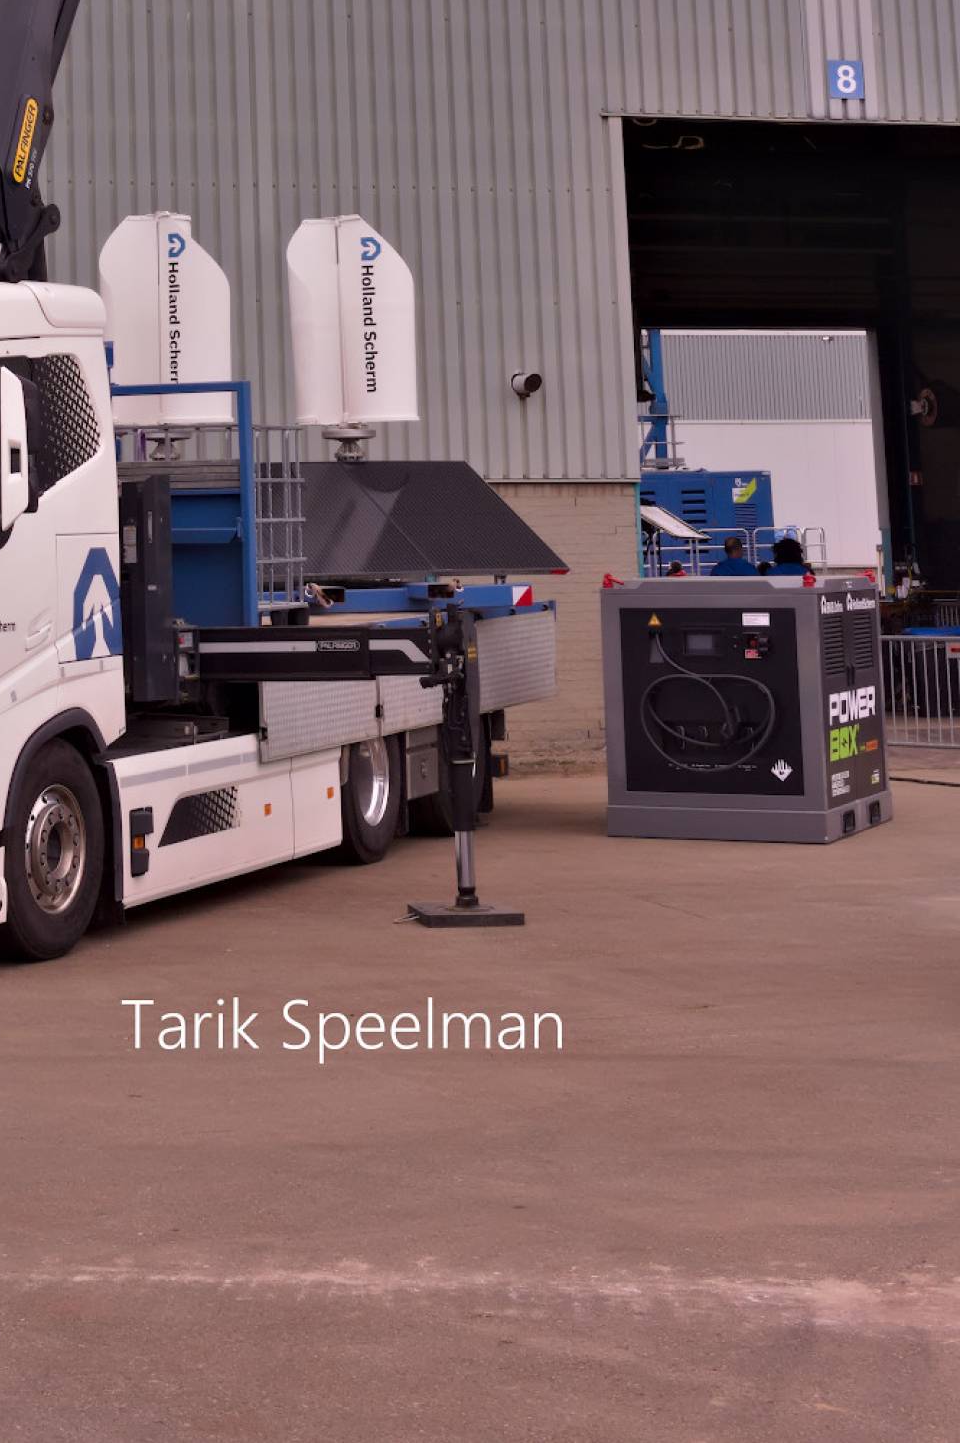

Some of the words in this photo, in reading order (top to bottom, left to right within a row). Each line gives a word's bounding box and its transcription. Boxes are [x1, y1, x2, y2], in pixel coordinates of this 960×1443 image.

[837, 64, 857, 94] 8
[168, 262, 181, 325] Holland
[361, 265, 377, 327] Holland
[363, 331, 378, 393] Scherm
[829, 685, 876, 727] POWER
[830, 723, 859, 762] BOX
